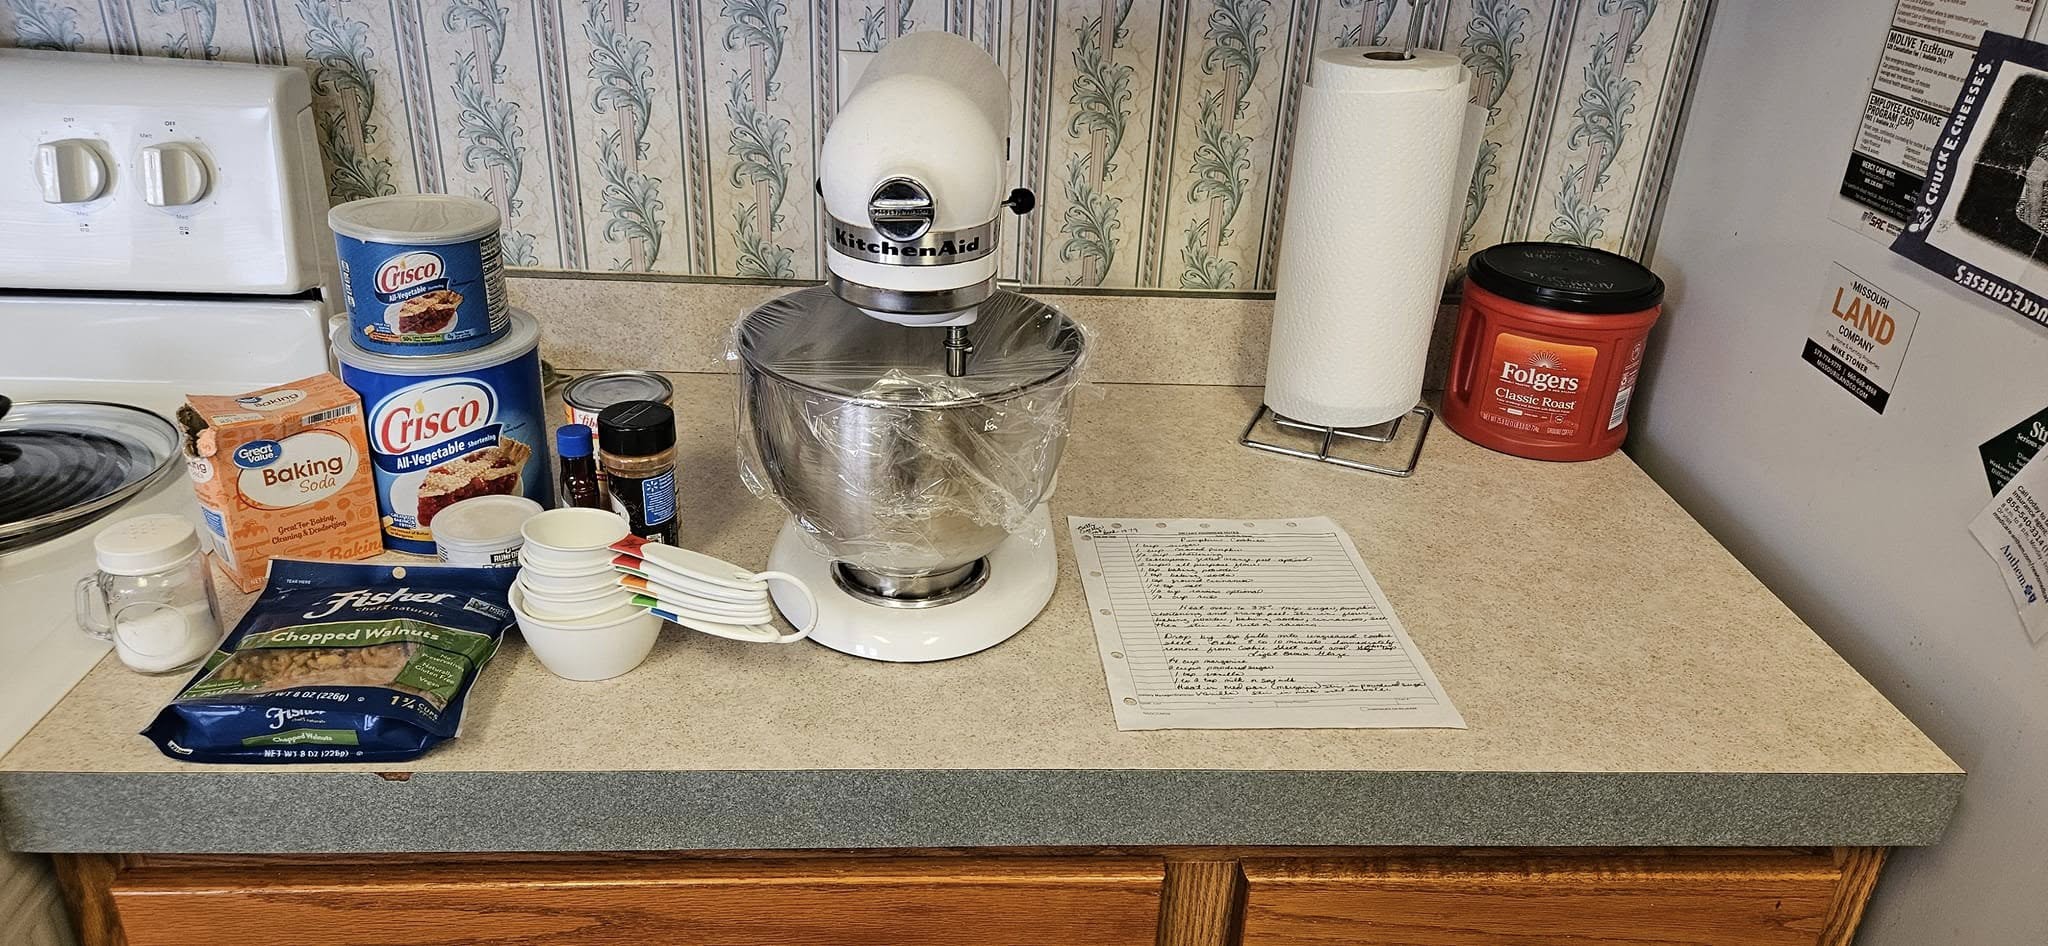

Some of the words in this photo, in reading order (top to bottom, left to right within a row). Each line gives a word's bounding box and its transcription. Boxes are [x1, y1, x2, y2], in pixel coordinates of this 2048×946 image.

[1889, 32, 1917, 48] MDLIVE
[1867, 105, 1899, 122] PROGRAM
[1898, 115, 1915, 130] (EAP)
[1870, 96, 1902, 114] EMPLOYEE
[1901, 106, 1942, 127] ASSISTANCE
[1925, 151, 1950, 206] CHUCK
[1951, 62, 1993, 137] CHEESE'S
[835, 227, 980, 257] KitchenAid
[381, 263, 437, 293] Crisco
[389, 285, 427, 302] All-Vegetable
[1852, 281, 1890, 310] MISSOURI
[1832, 286, 1896, 346] LAND
[1838, 324, 1875, 353] COMPANY
[1831, 343, 1845, 358] MIKE
[1845, 353, 1868, 374] STONER
[1500, 361, 1579, 392] Folgers
[254, 393, 299, 408] Baking
[1495, 387, 1540, 406] Classic
[1541, 397, 1576, 410] Roast
[381, 399, 480, 454] Crisco
[239, 444, 273, 459] Great
[248, 453, 275, 464] Value
[397, 440, 465, 470] All-Vegetable
[467, 433, 496, 448] Shortening
[262, 456, 343, 487] Baking
[299, 475, 337, 494] Soda
[2017, 485, 2029, 498] Call
[2027, 496, 2041, 514] today
[2039, 511, 2047, 521] to
[272, 532, 303, 545] Cleaning
[309, 520, 347, 535] Deodorizing
[278, 524, 297, 535] Great
[298, 521, 309, 529] For
[2006, 497, 2044, 546] 855-540-3314
[302, 587, 455, 619] Fisher
[355, 604, 391, 613] chef's
[391, 605, 440, 618] naturals
[271, 629, 360, 645] Chopped
[365, 626, 441, 642] Walnuts
[415, 665, 438, 677] Gluten
[440, 675, 454, 684] Free
[421, 653, 465, 673] Preservatives
[422, 662, 454, 678] Naturally
[419, 676, 440, 688] Vegan
[317, 692, 350, 702] (226g)
[418, 703, 439, 720] CUPS
[272, 732, 306, 744] Chopped
